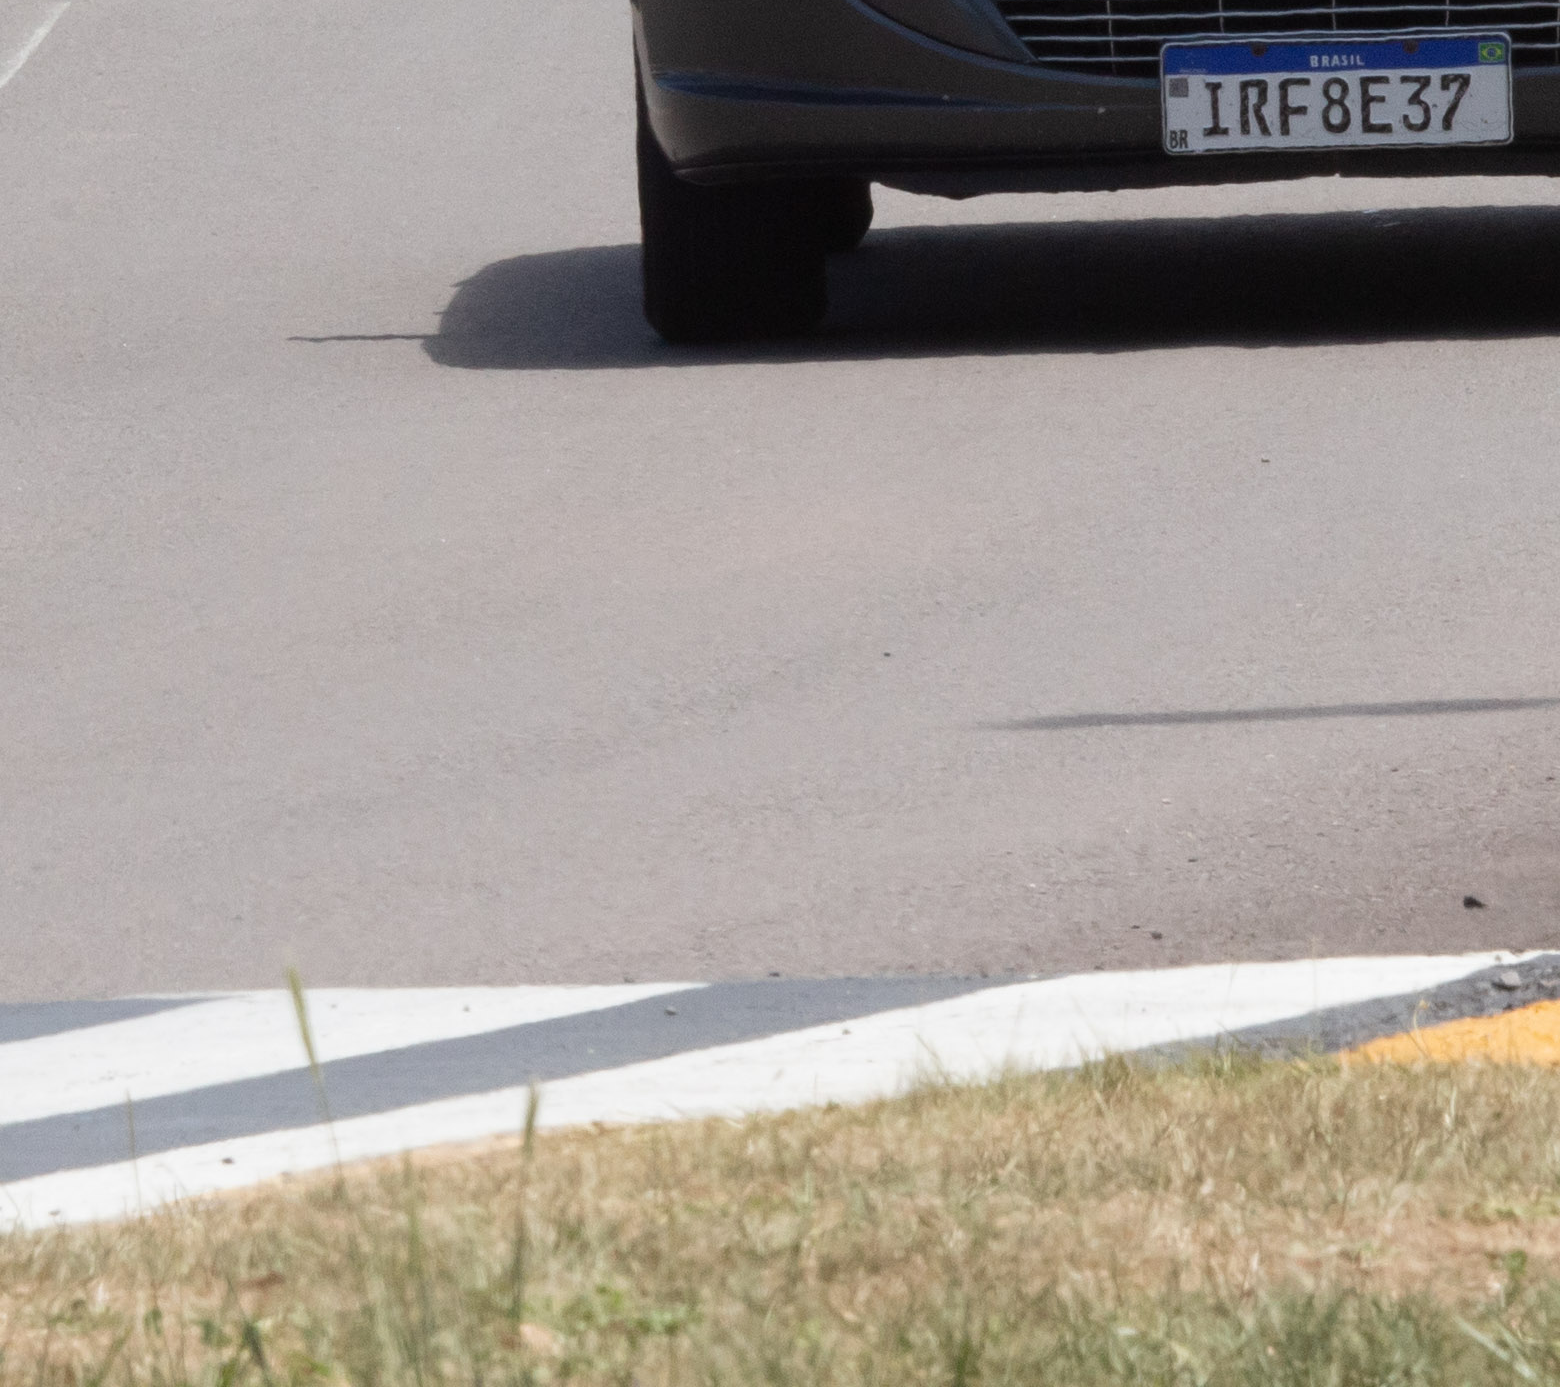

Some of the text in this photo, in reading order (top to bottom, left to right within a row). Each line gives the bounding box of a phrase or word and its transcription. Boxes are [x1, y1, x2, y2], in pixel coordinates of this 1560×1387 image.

[1309, 54, 1365, 69] BRASIL
[1202, 73, 1472, 138] IRF8E37
[1169, 129, 1189, 150] BR
